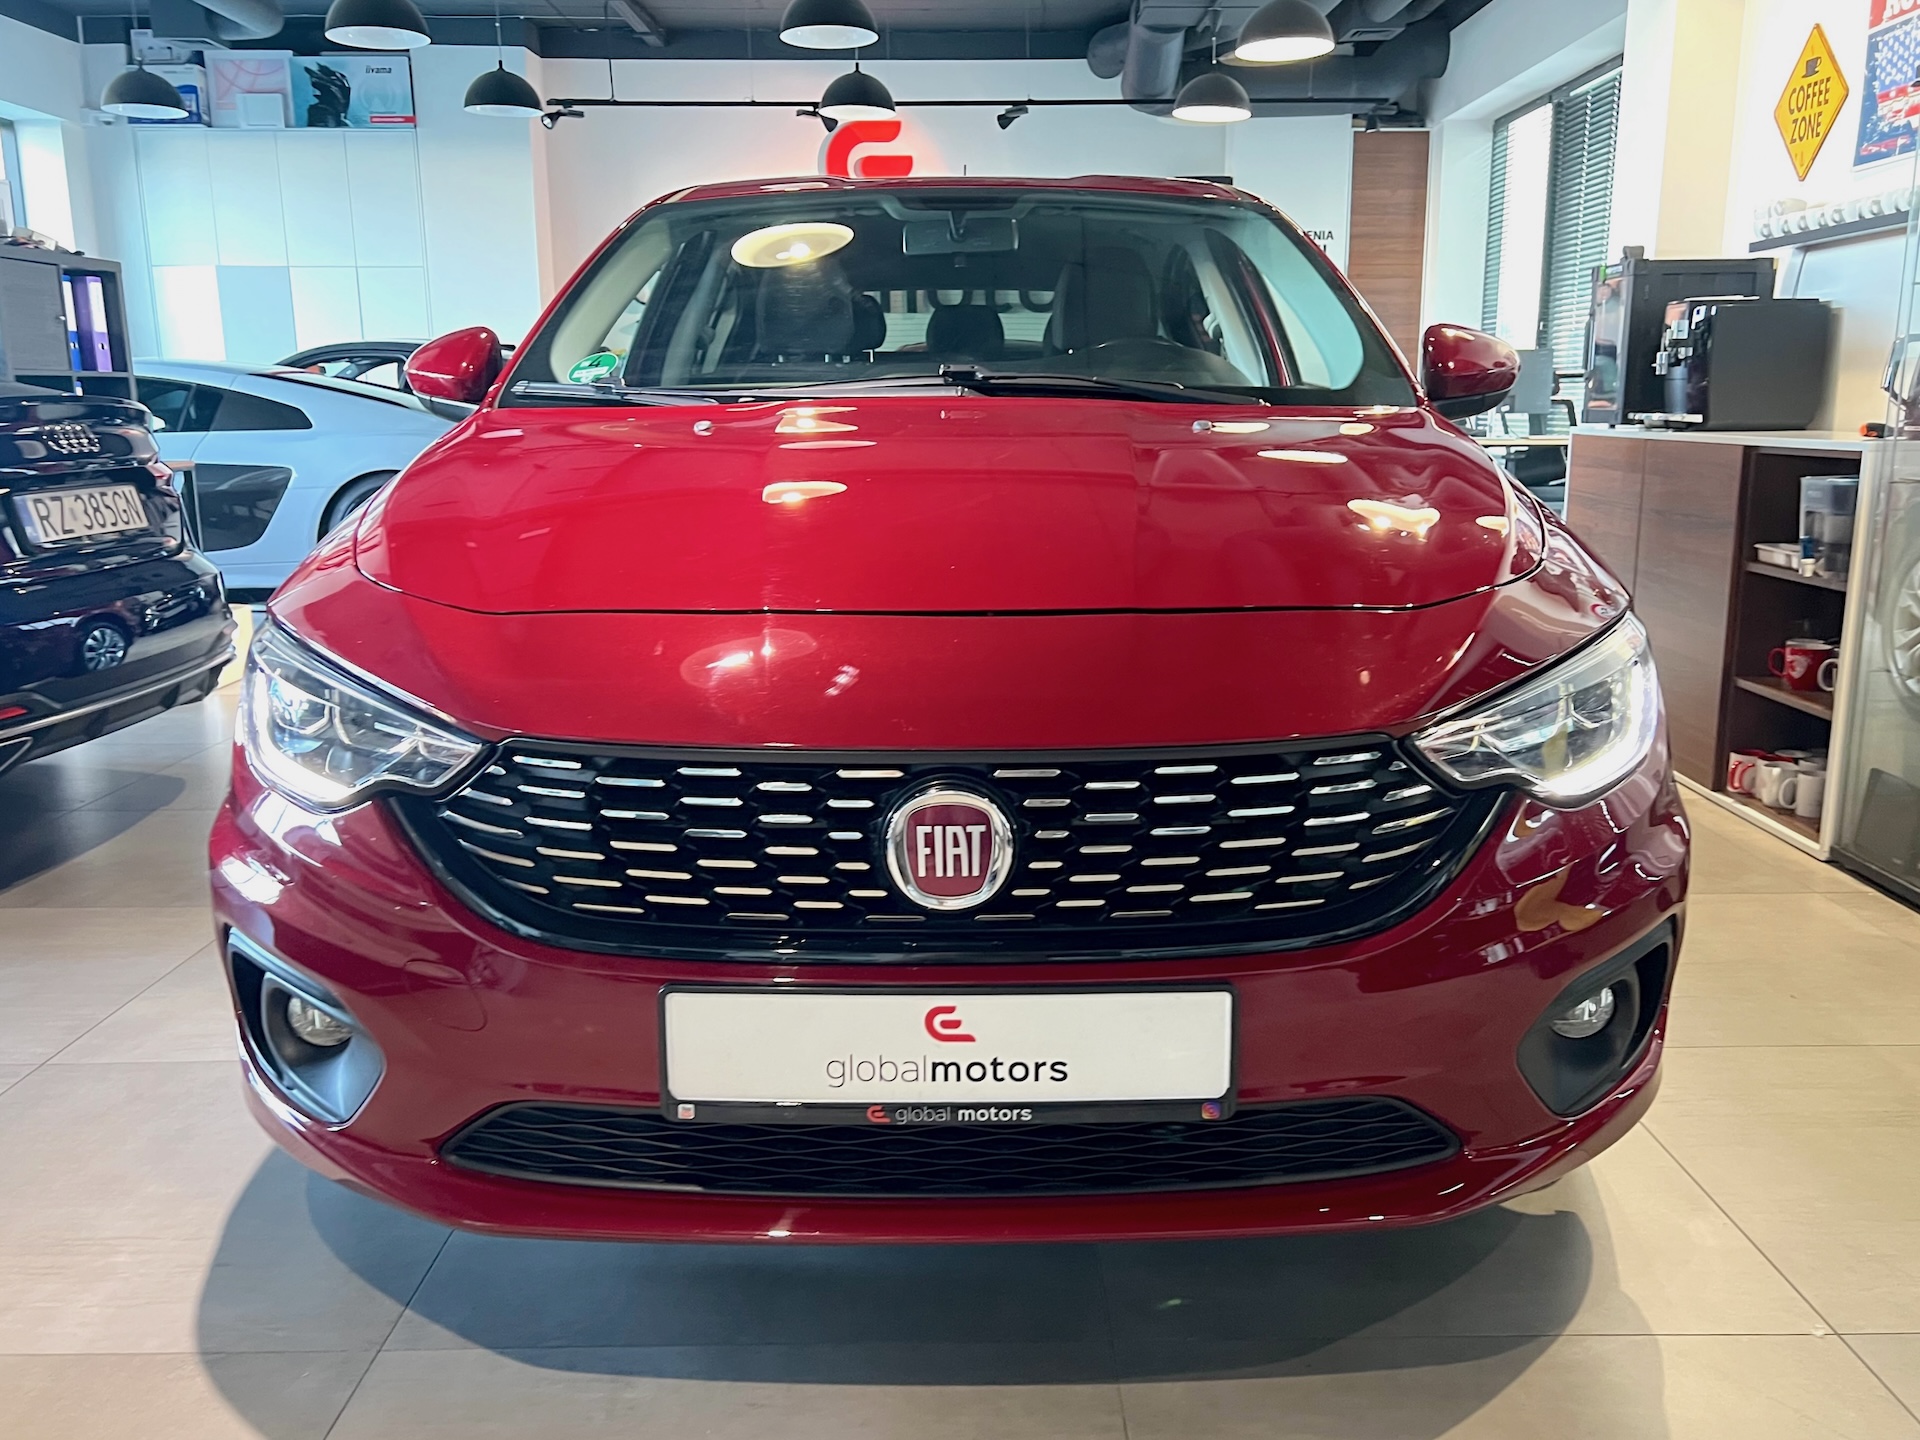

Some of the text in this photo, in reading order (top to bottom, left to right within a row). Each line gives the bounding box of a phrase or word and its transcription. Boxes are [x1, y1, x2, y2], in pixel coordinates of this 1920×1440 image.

[1788, 76, 1831, 115] COFFEE
[1789, 111, 1823, 144] ZONE
[588, 355, 602, 367] 4
[32, 489, 143, 538] RZ 385GN
[916, 825, 987, 878] FIAT
[826, 1054, 1068, 1088] globalmotors
[895, 1106, 1033, 1125] global motors
